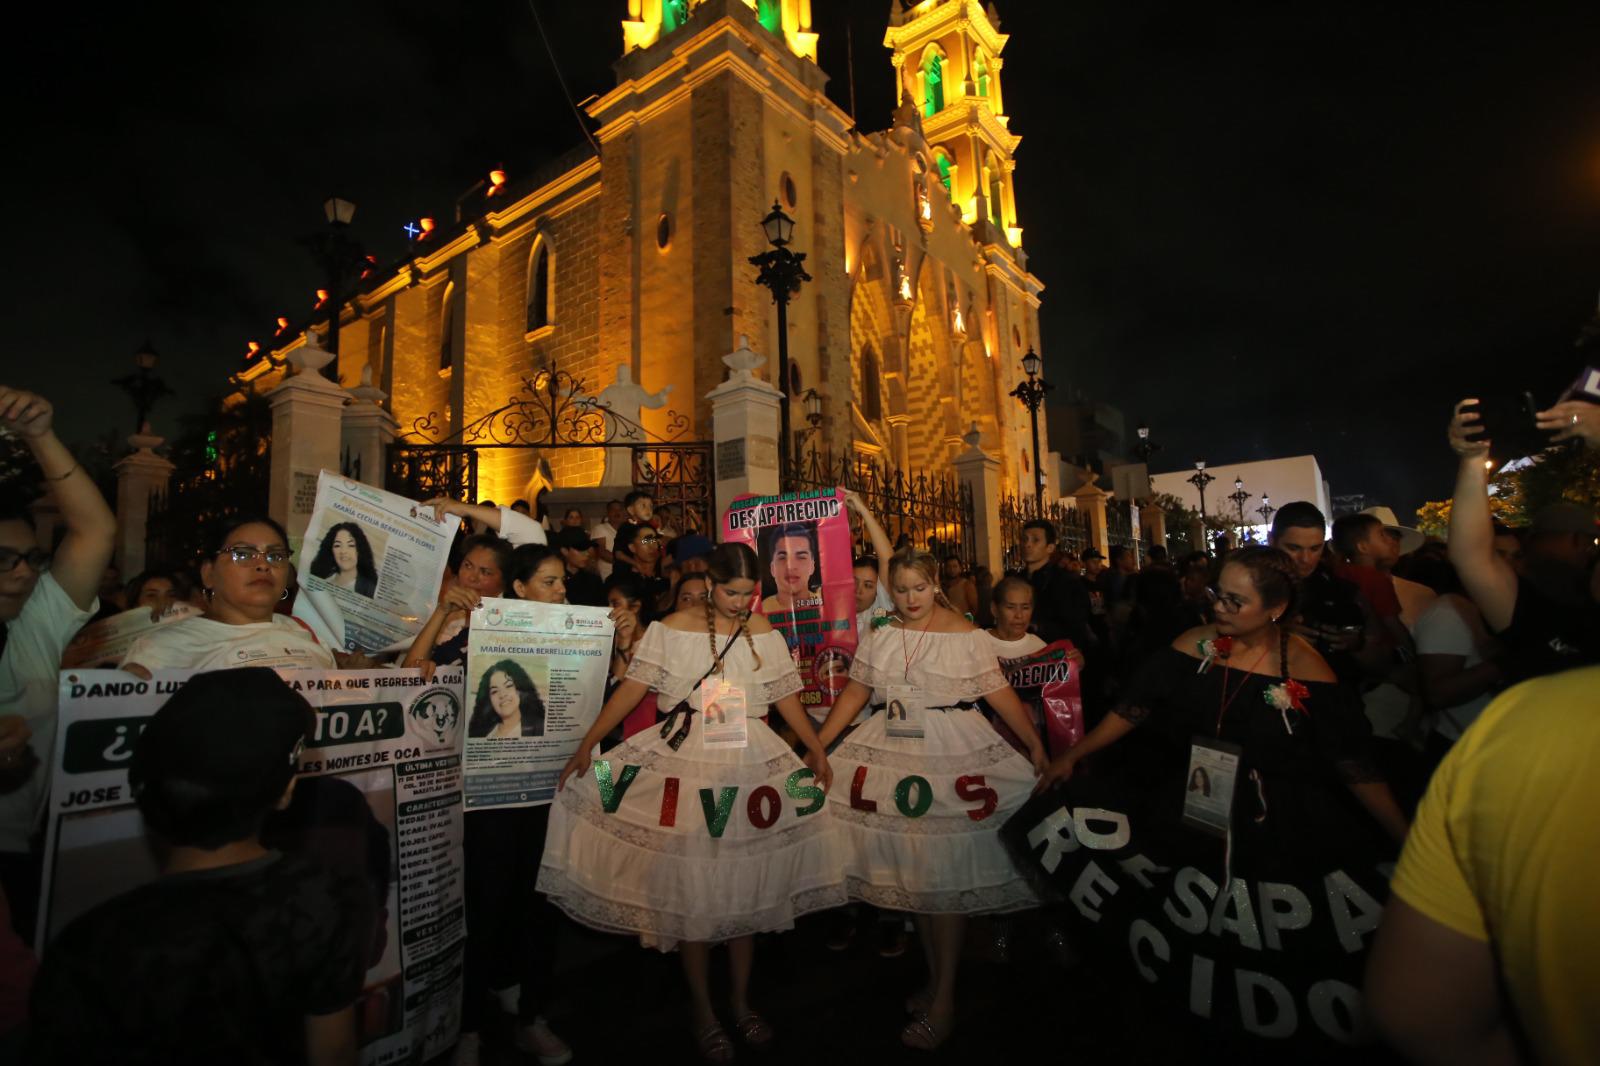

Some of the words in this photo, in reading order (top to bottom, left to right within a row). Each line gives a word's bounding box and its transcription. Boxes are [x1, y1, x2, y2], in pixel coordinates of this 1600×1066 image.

[729, 498, 840, 531] DESAPARECIDO
[480, 644, 506, 655] MARÍA
[507, 646, 535, 656] CECILIA
[578, 648, 603, 658] FLORES
[71, 681, 149, 699] DANDO
[307, 678, 343, 691] PARA
[346, 677, 370, 690] QUE
[374, 676, 426, 688] REGRESEN
[432, 674, 440, 685] A
[442, 673, 463, 685] CASA
[355, 707, 389, 737] A?
[326, 754, 372, 771] MONTES
[373, 750, 390, 763] DE
[394, 747, 421, 761] OCA
[61, 785, 122, 808] JOSE
[593, 759, 827, 838] VIVOS
[850, 766, 999, 822] LOS
[1072, 805, 1395, 955] DESAPA
